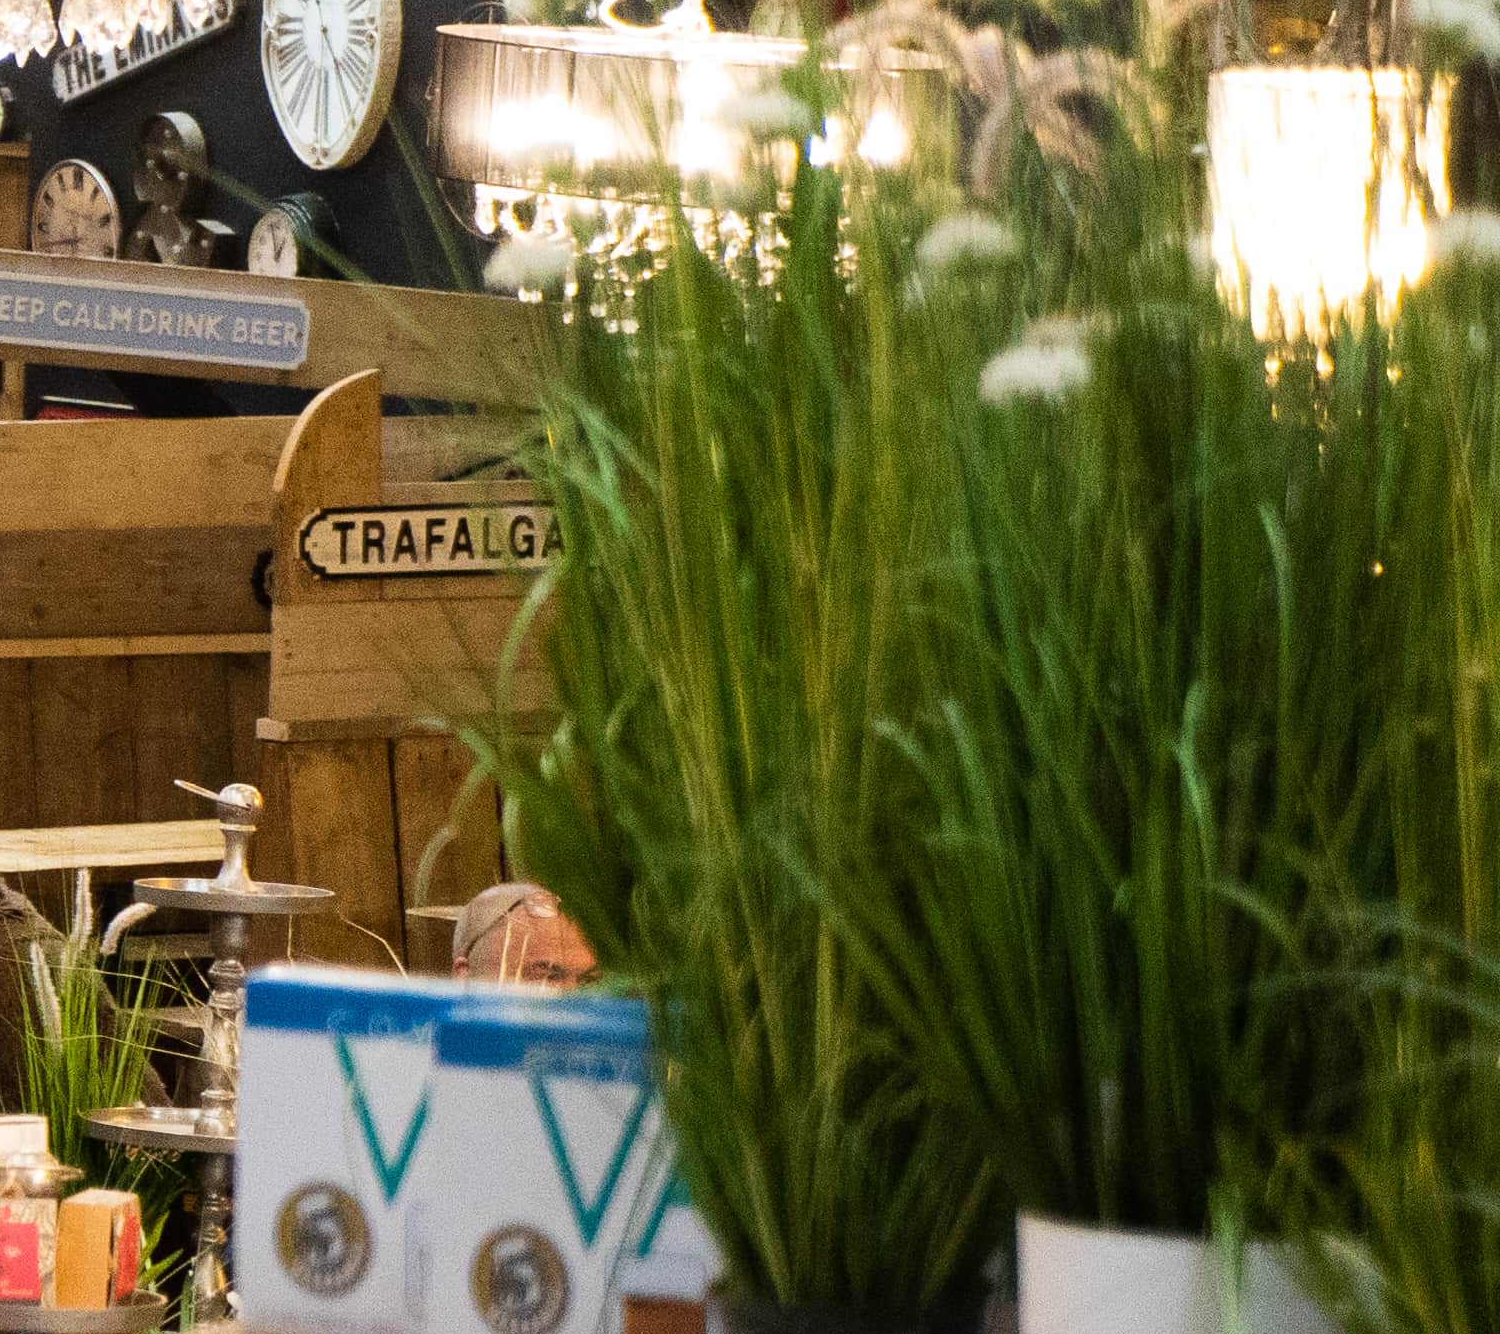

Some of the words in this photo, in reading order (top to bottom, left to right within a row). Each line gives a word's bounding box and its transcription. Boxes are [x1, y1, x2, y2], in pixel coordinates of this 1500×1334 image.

[52, 299, 132, 332] CALM
[138, 307, 224, 340] DRINK
[231, 316, 297, 348] BEER
